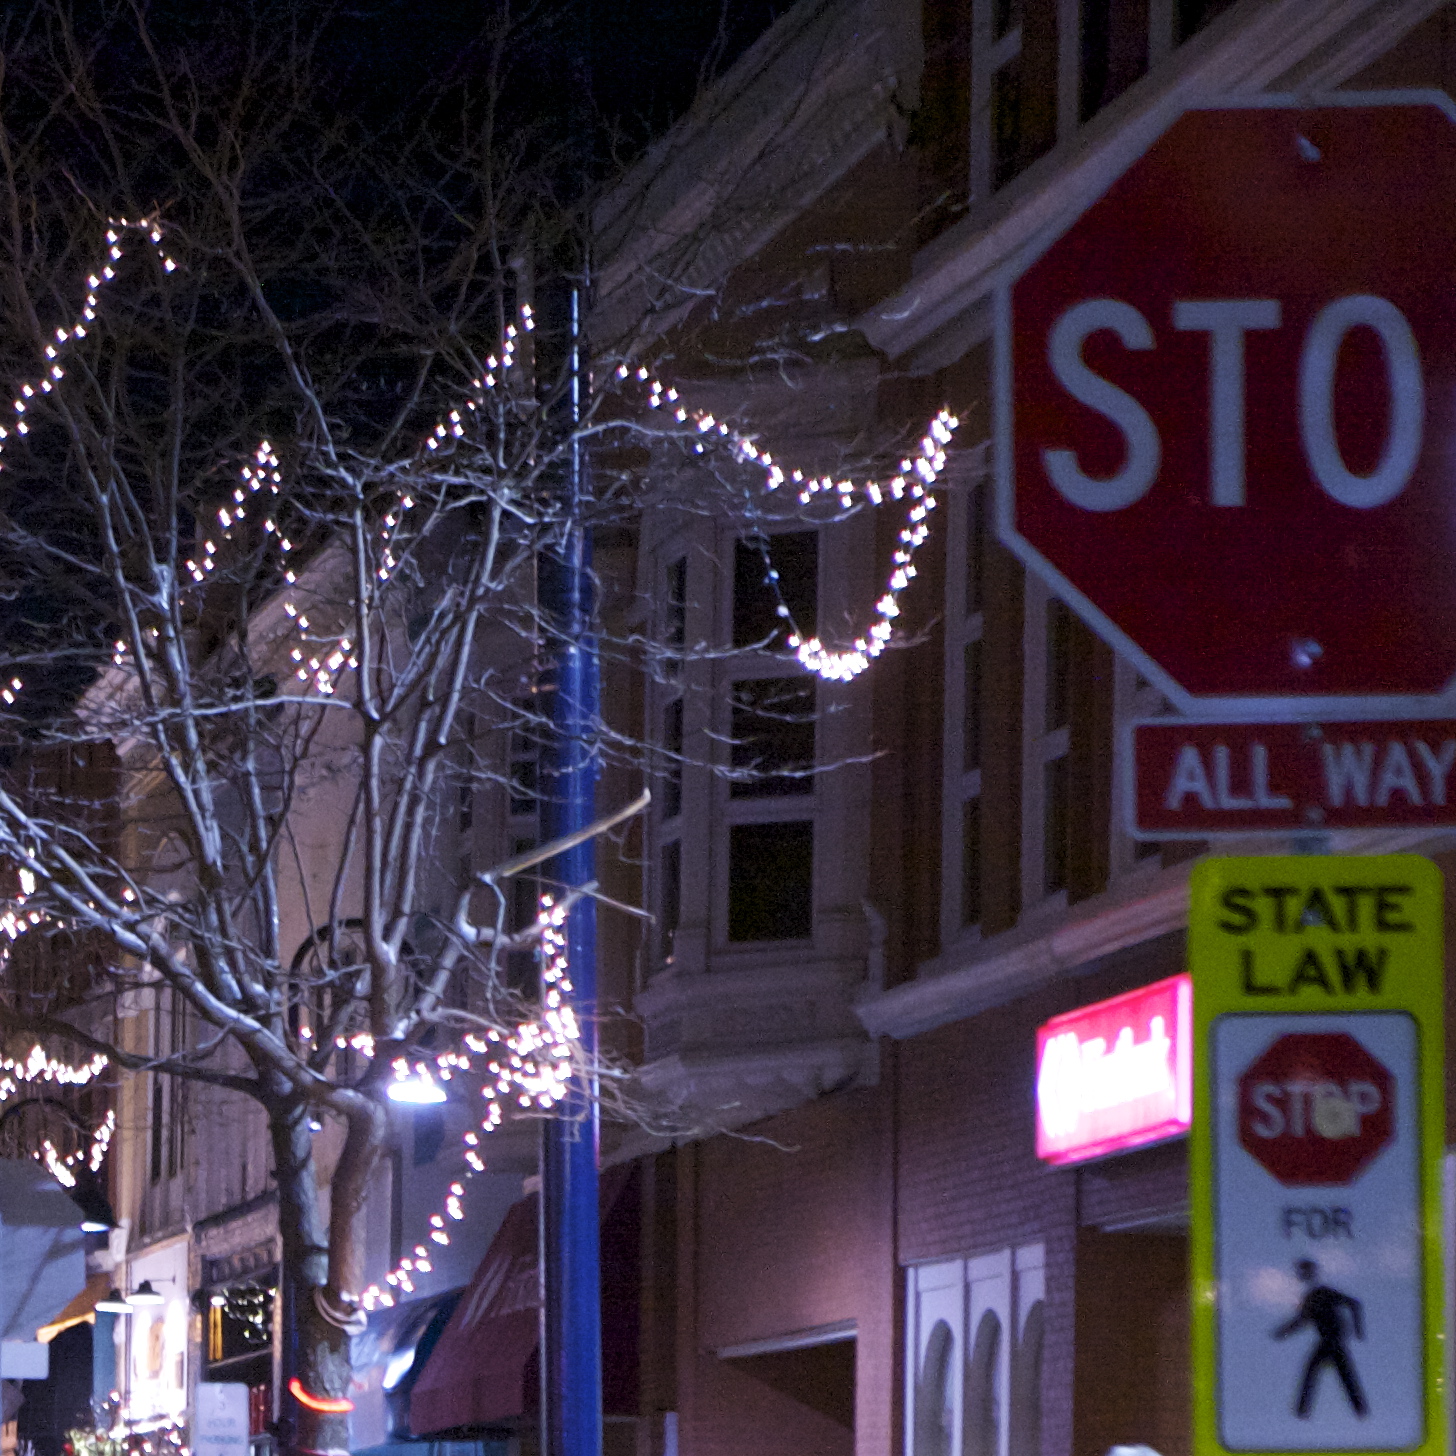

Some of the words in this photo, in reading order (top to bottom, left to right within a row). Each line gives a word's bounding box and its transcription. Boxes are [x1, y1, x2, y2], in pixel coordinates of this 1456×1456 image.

[1043, 295, 1425, 511] STO
[1166, 744, 1293, 810] ALL
[1322, 741, 1456, 806] WAY
[1218, 885, 1415, 936] STATE
[1242, 947, 1388, 995] LAW
[1282, 1207, 1353, 1239] FOR
